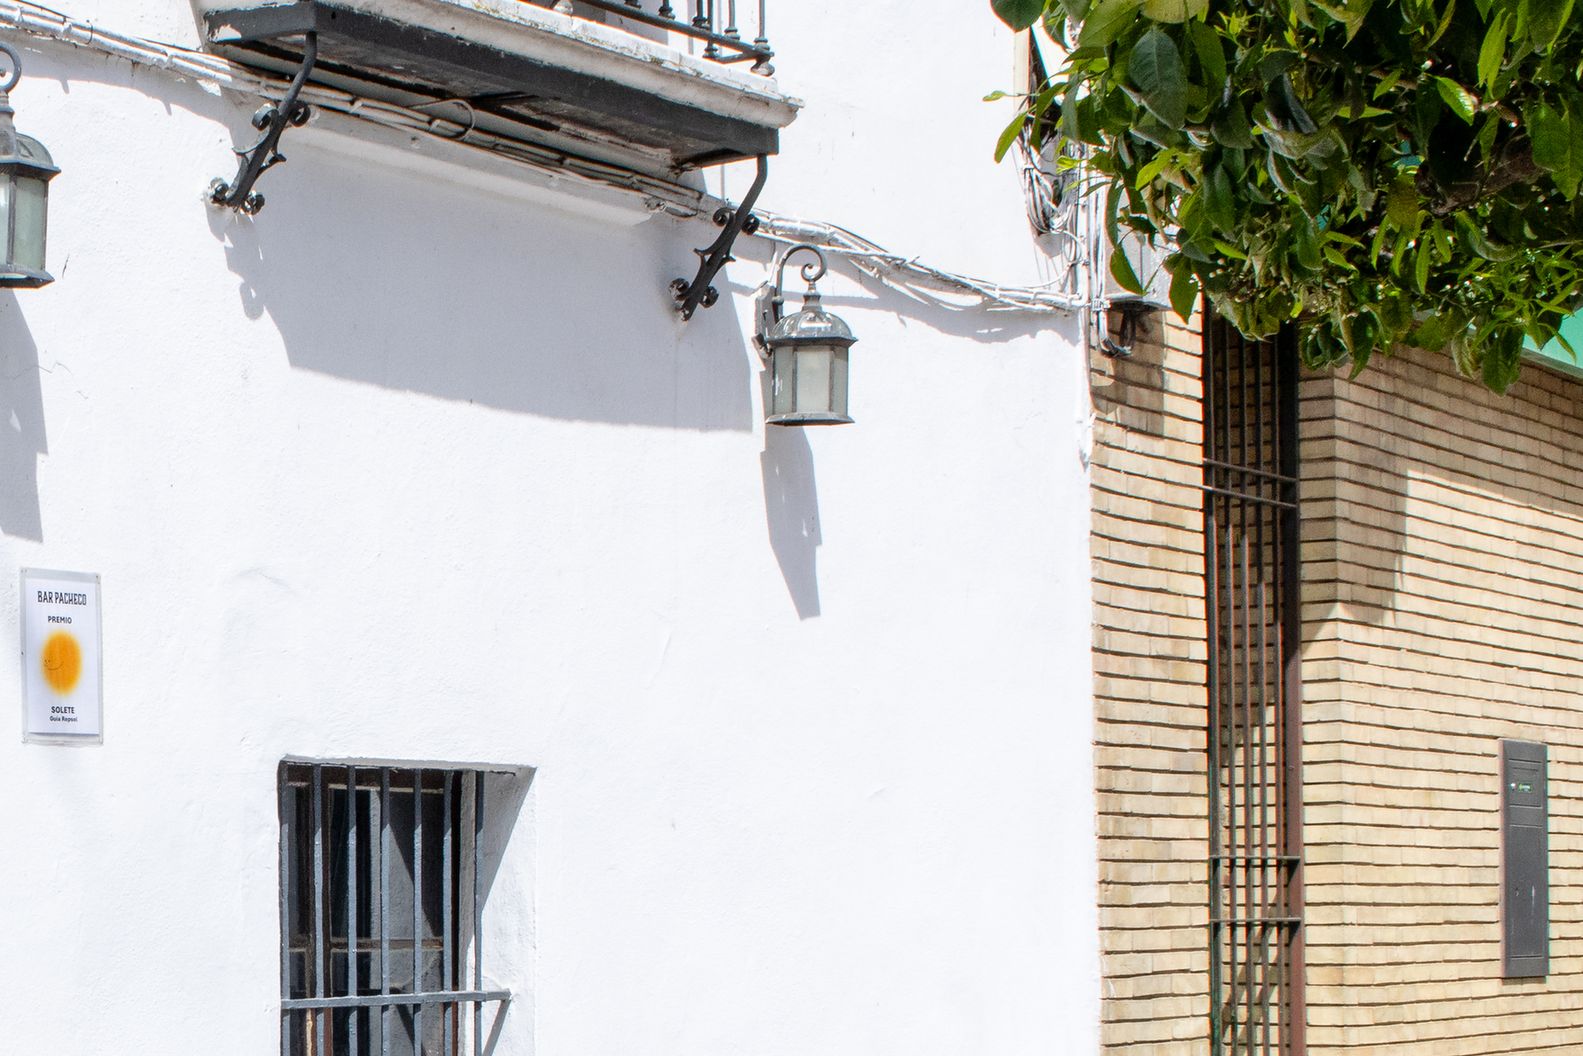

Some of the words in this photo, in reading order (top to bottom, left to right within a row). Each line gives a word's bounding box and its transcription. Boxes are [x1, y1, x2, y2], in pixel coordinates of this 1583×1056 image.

[38, 591, 53, 603] BAR
[54, 592, 86, 605] PACHECO
[48, 616, 72, 624] PREMIO
[51, 706, 75, 714] SOLETE
